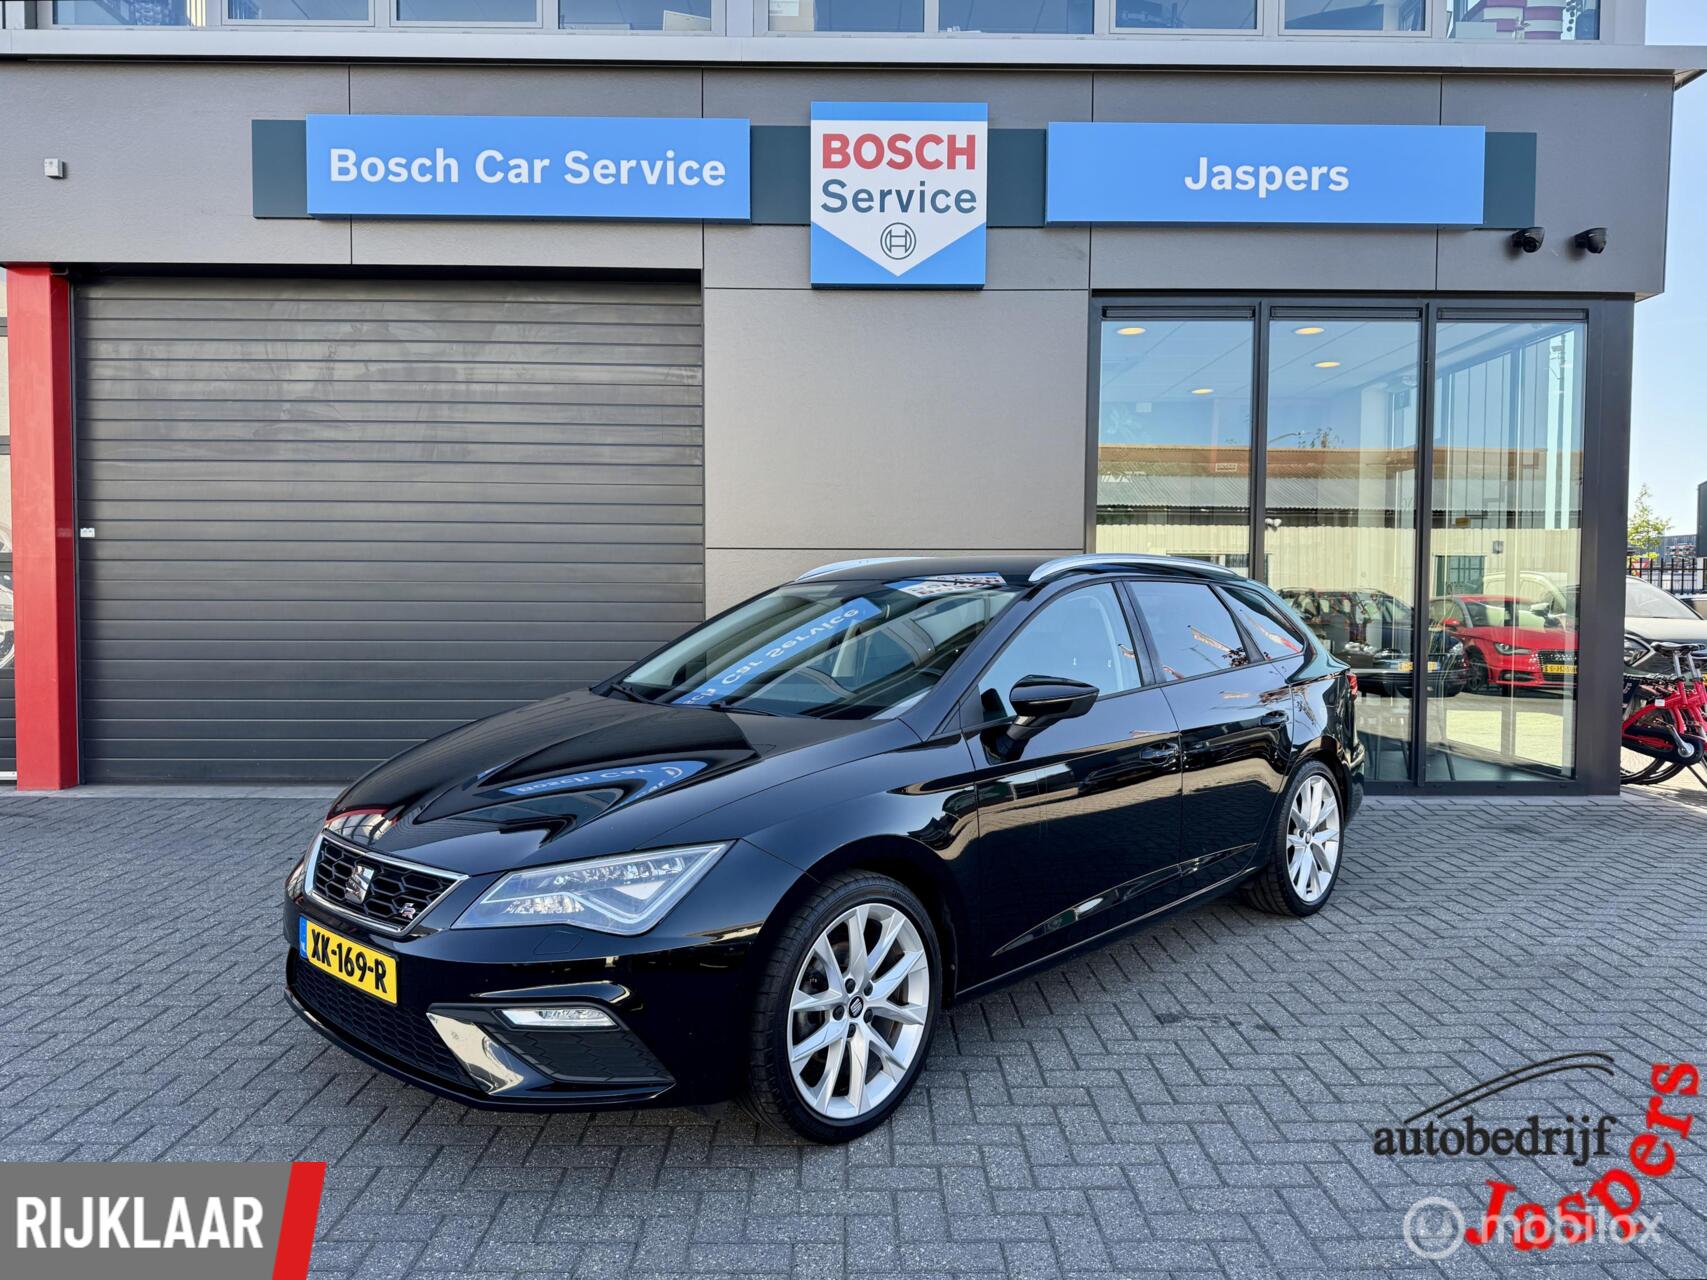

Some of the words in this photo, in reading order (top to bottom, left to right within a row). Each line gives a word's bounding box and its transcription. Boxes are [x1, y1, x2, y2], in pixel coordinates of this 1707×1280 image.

[329, 148, 459, 183] Bosch
[475, 150, 550, 184] Car
[564, 150, 726, 186] Service
[823, 134, 977, 170] BOSCH
[820, 178, 977, 214] Service
[1184, 157, 1350, 199] Jaspers
[311, 929, 388, 994] XK-169-R
